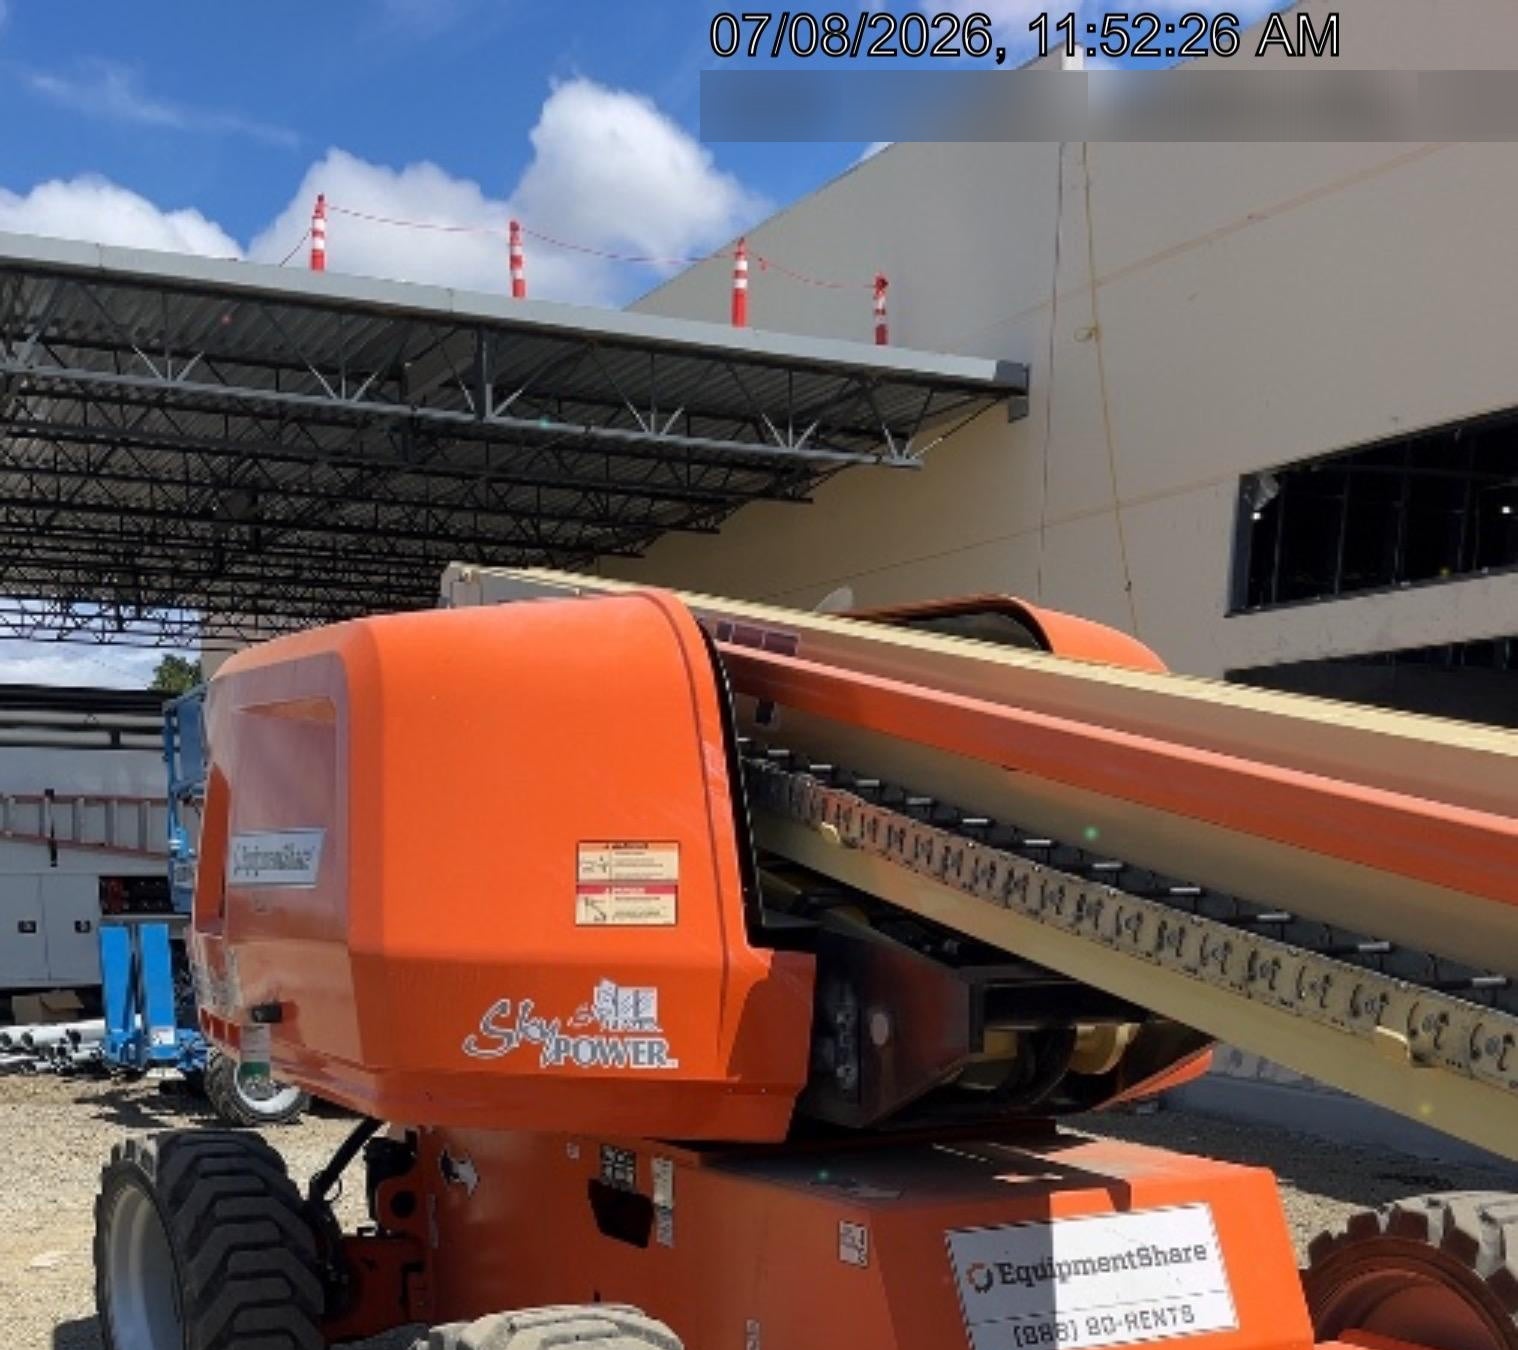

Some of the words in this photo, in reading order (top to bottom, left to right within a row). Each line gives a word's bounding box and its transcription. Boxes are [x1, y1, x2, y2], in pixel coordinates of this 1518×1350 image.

[462, 998, 561, 1068] Sky
[551, 1036, 668, 1069] POWER
[998, 1243, 1208, 1288] EquipmentShare
